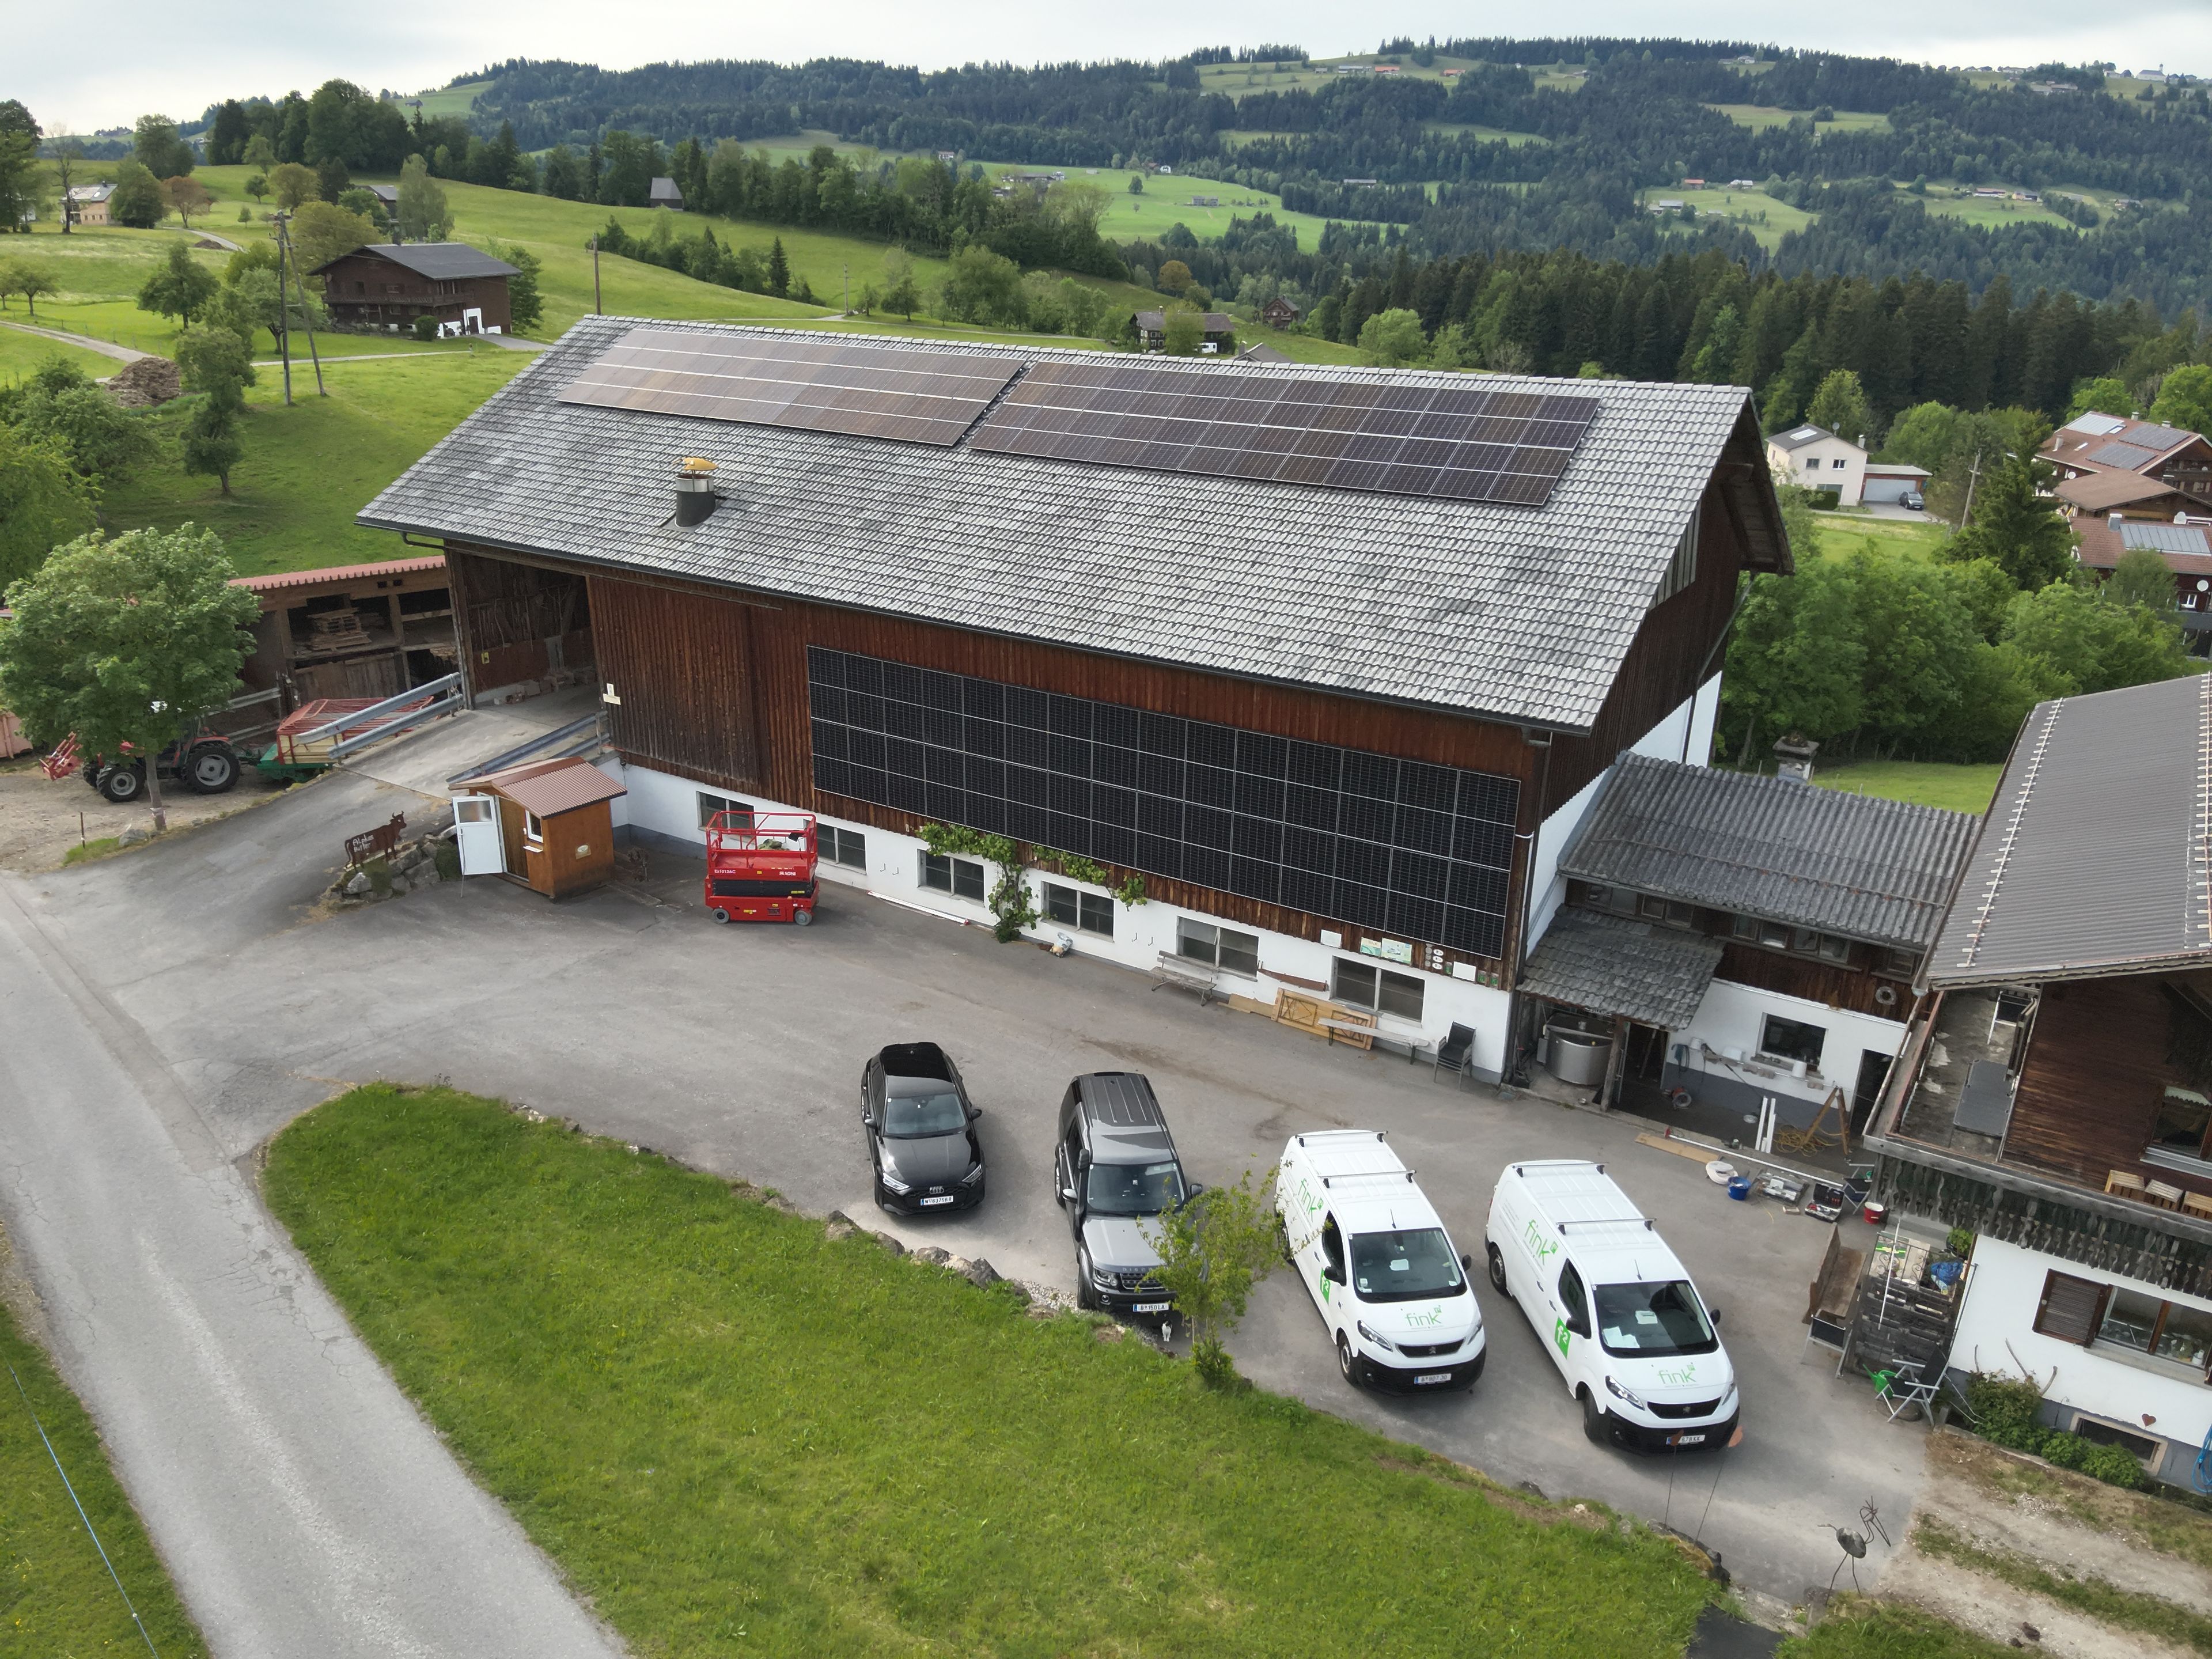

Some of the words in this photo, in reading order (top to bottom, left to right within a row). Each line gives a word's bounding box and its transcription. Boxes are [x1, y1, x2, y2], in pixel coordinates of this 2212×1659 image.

[1297, 1178, 1318, 1222] fink
[1524, 1219, 1550, 1266] fink
[1405, 1311, 1442, 1327] fink
[1657, 1369, 1696, 1384] fink
